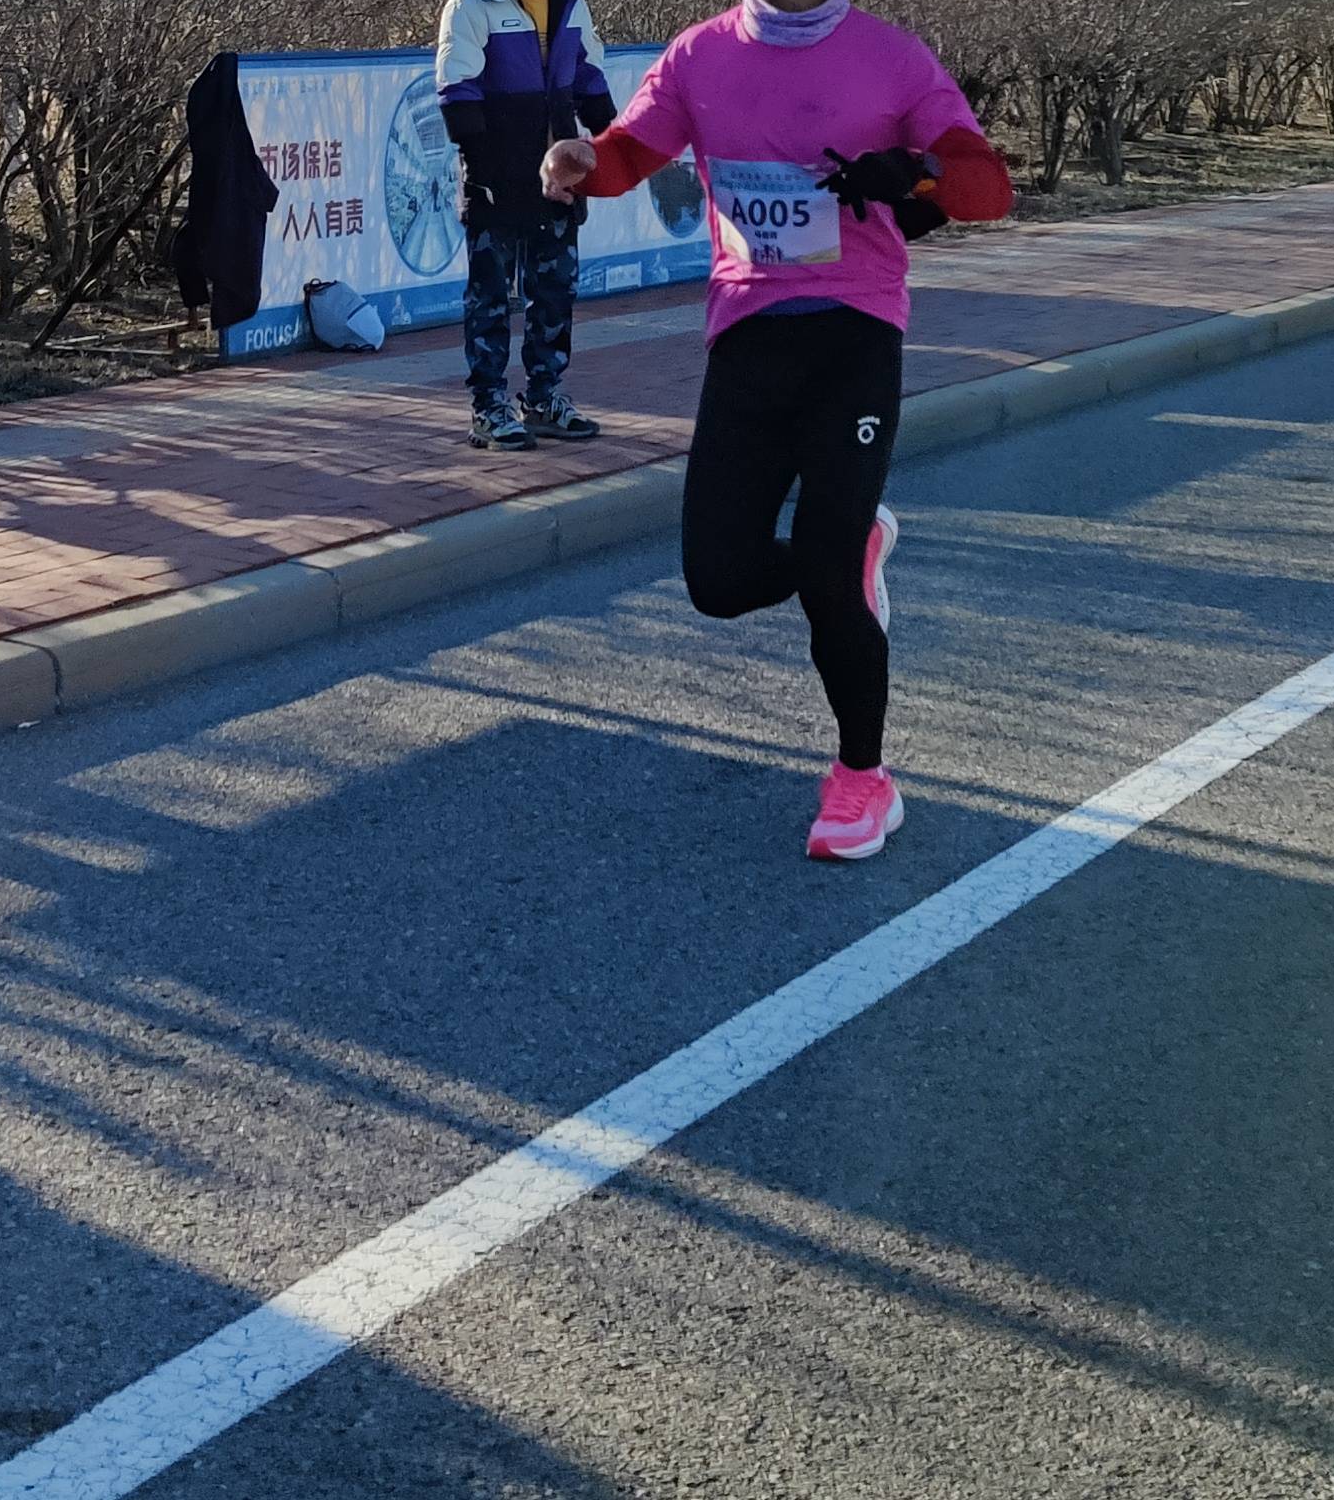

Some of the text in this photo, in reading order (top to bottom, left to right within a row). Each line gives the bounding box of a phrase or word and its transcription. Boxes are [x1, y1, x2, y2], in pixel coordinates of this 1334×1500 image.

[259, 139, 343, 183] 市场保洁
[282, 198, 365, 242] 人人有责
[731, 197, 811, 228] A005
[245, 323, 293, 352] FOCUS
